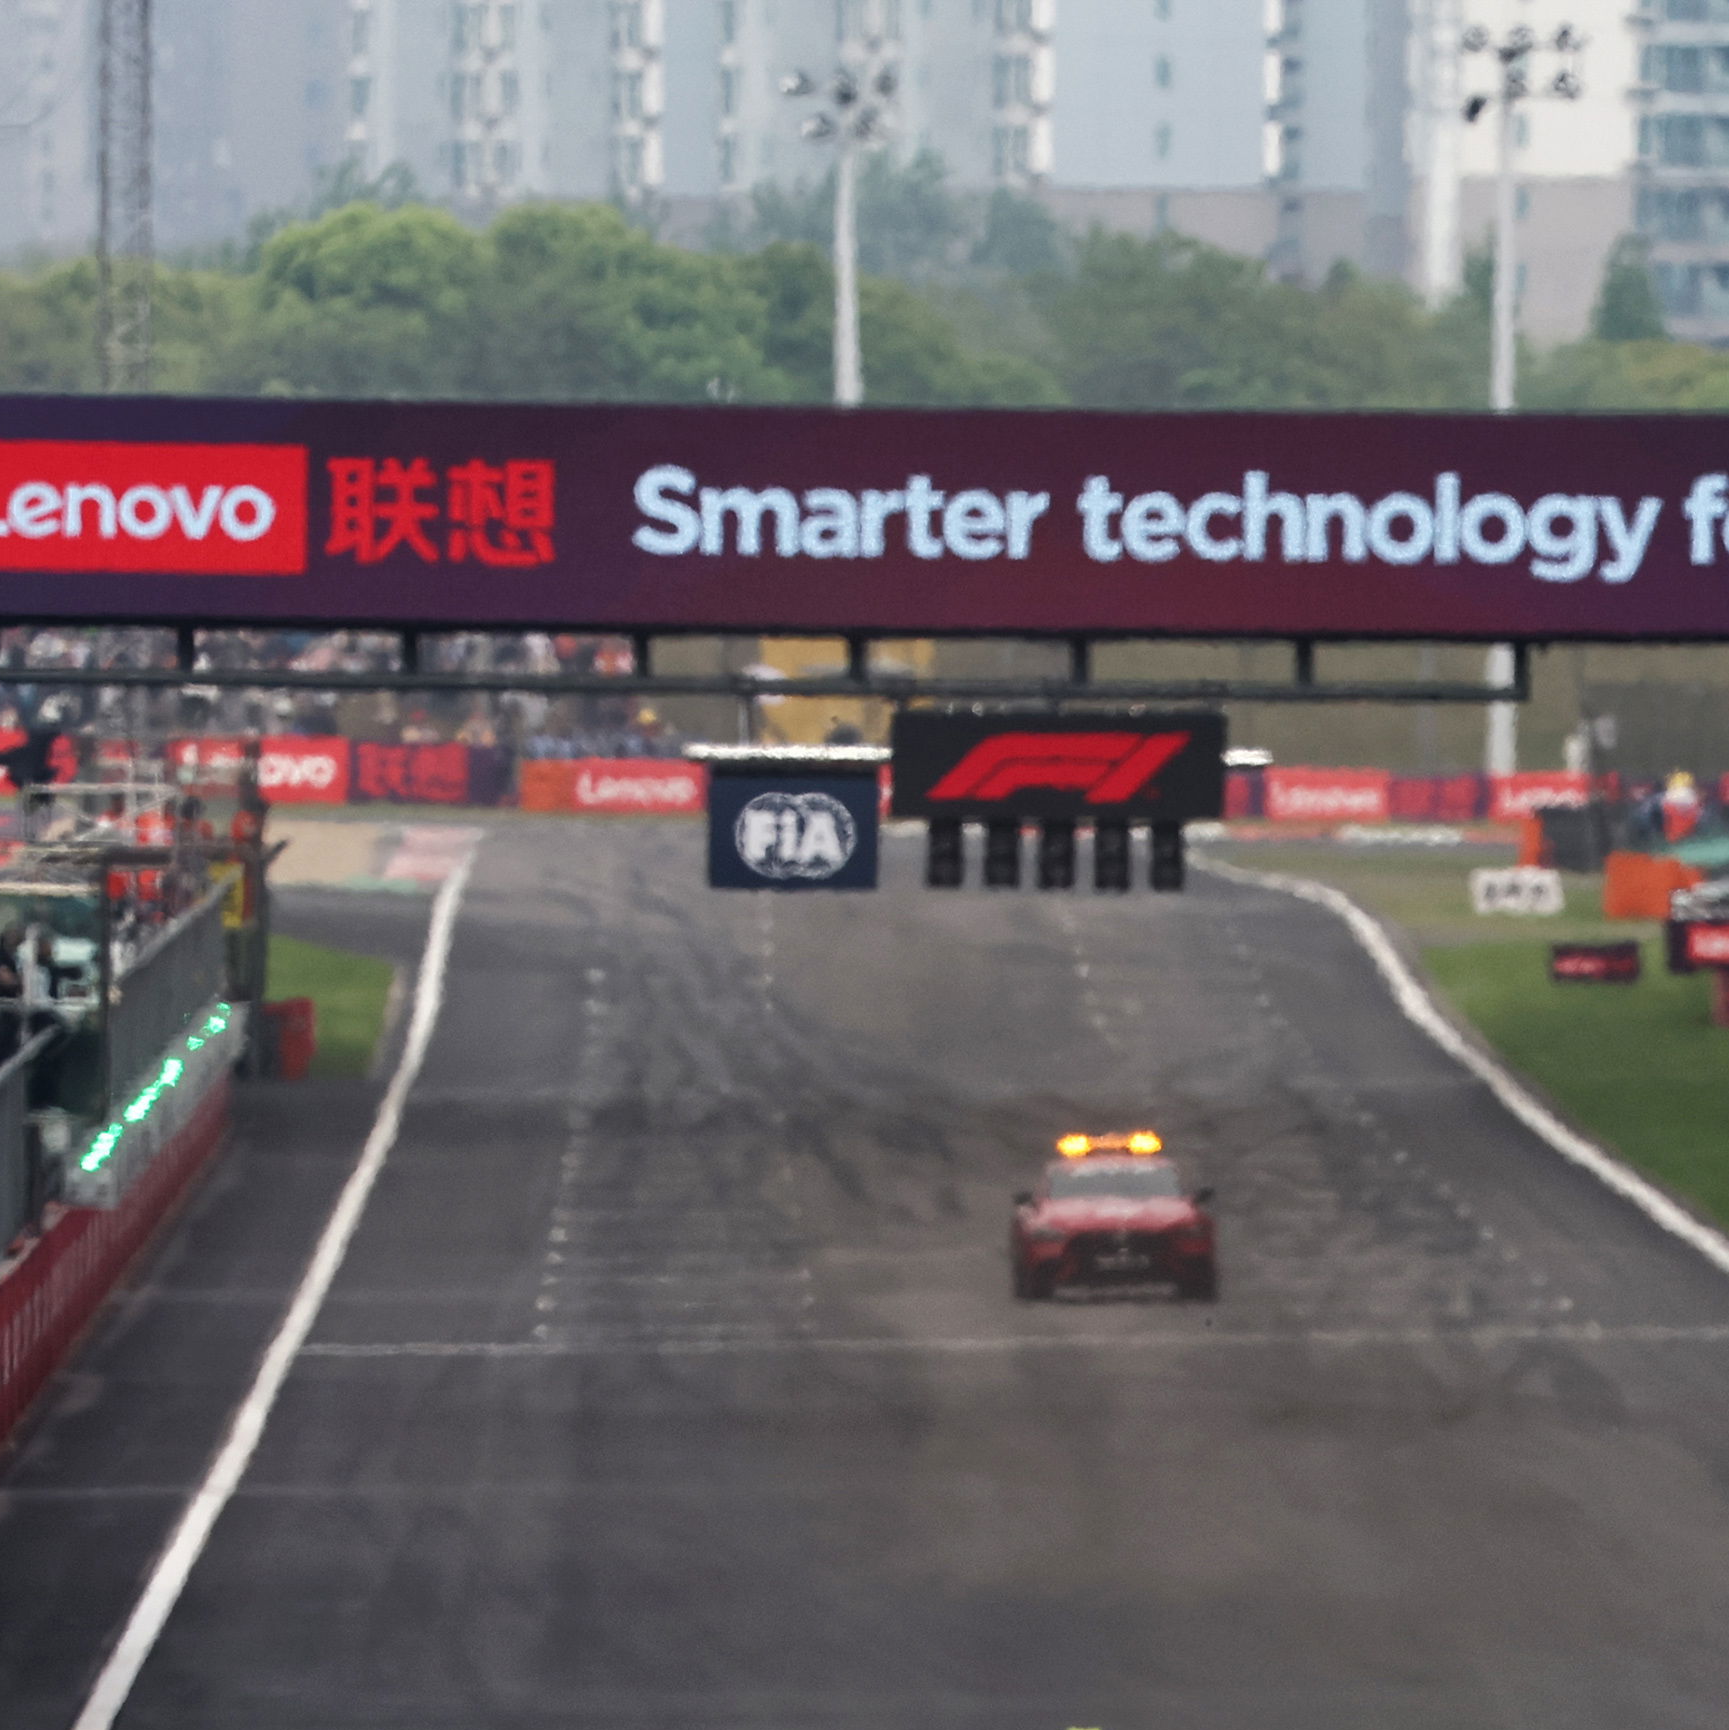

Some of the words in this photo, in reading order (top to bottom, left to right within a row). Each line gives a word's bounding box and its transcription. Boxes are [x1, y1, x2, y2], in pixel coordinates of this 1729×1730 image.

[324, 456, 559, 567] 联想
[632, 464, 1051, 561] Smarter
[1076, 468, 1664, 584] technology
